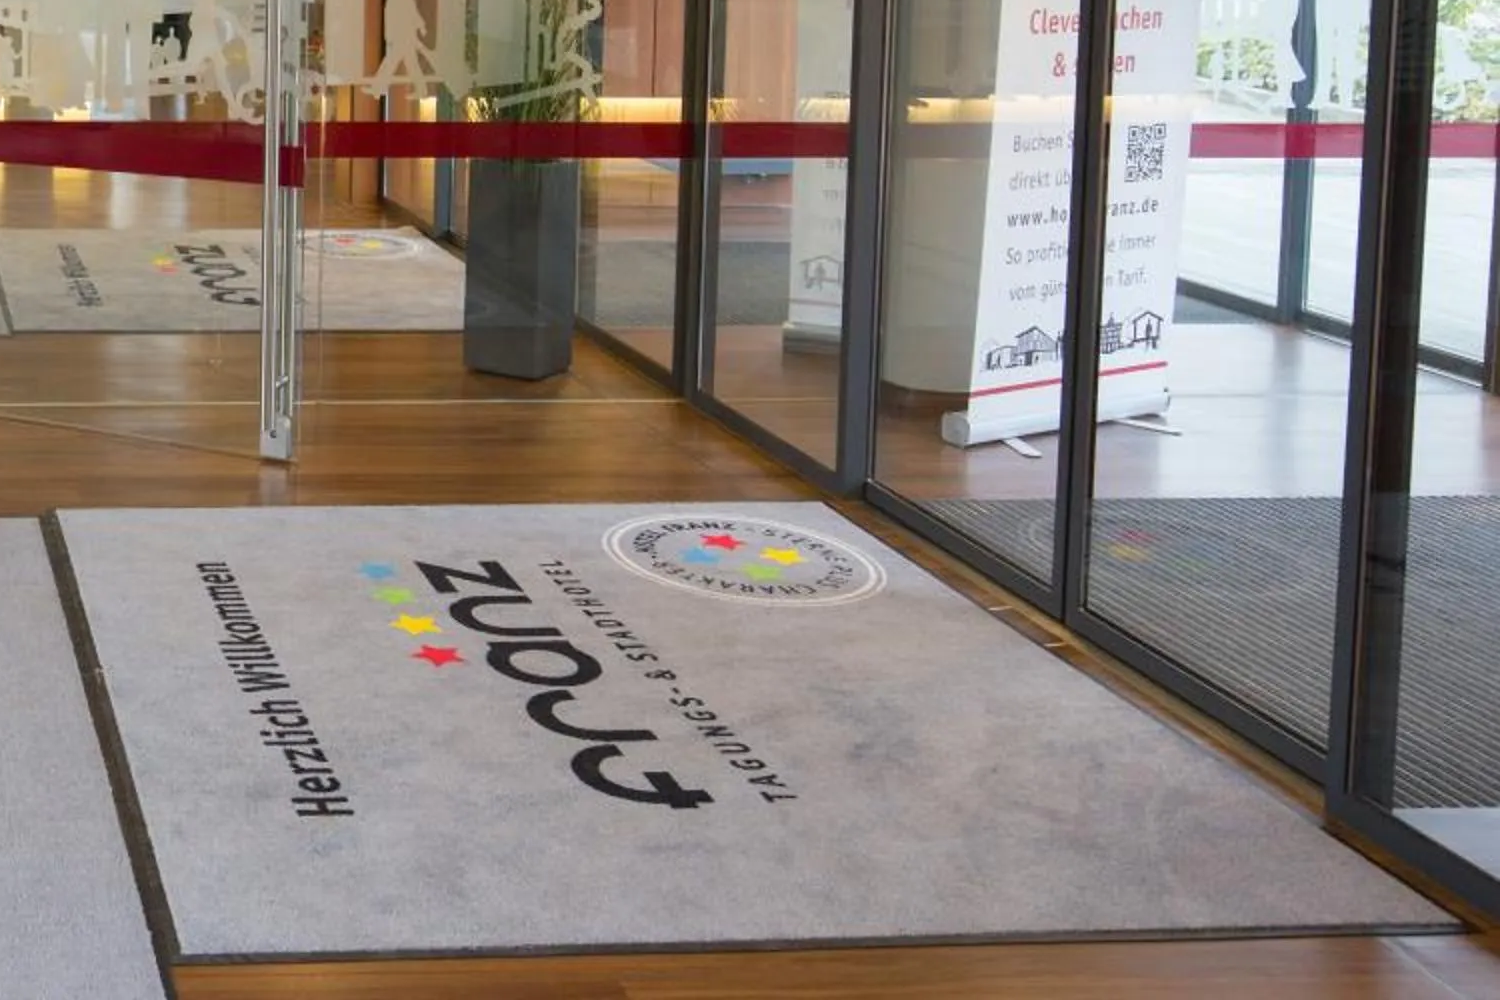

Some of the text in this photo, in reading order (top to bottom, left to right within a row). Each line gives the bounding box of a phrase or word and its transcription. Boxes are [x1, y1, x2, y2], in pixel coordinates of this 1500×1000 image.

[1030, 4, 1164, 35] Cleve chen
[1052, 52, 1066, 77] &
[1013, 134, 1063, 152] Buchen
[1009, 169, 1050, 190] direkt
[1006, 247, 1022, 265] So
[1117, 233, 1156, 250] immer
[1010, 286, 1036, 301] vom
[662, 521, 736, 532] FRANZ
[196, 561, 355, 817] Herzlich Willkommen
[414, 560, 715, 810] franz
[538, 560, 798, 804] TAGUNGS- & STADTHOTEL
